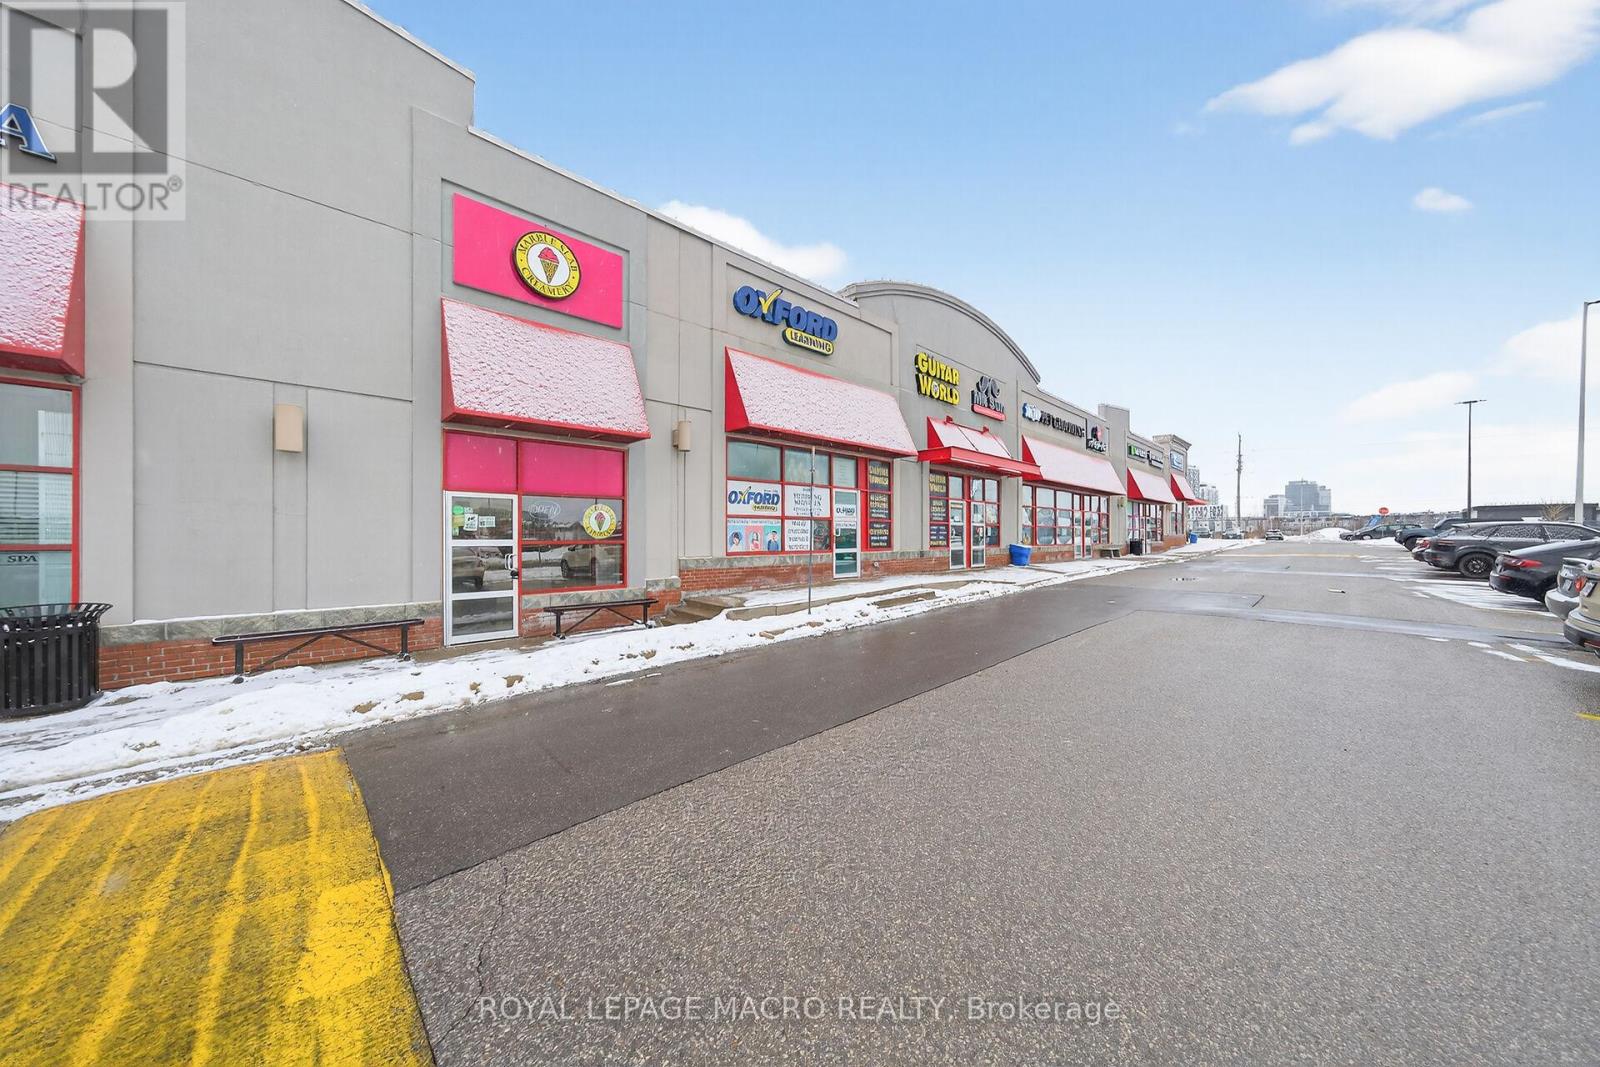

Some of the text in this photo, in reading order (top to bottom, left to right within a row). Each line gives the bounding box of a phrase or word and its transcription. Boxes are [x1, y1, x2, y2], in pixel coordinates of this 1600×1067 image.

[518, 233, 578, 272] MARBLE SLAB
[522, 267, 574, 296] CREAMERY
[733, 286, 838, 341] OXFORD
[790, 331, 832, 353] LEARNING
[916, 352, 960, 385] GUITAR
[916, 374, 960, 405] WORLD
[728, 488, 780, 505] OXFORD
[8, 555, 37, 563] SPA
